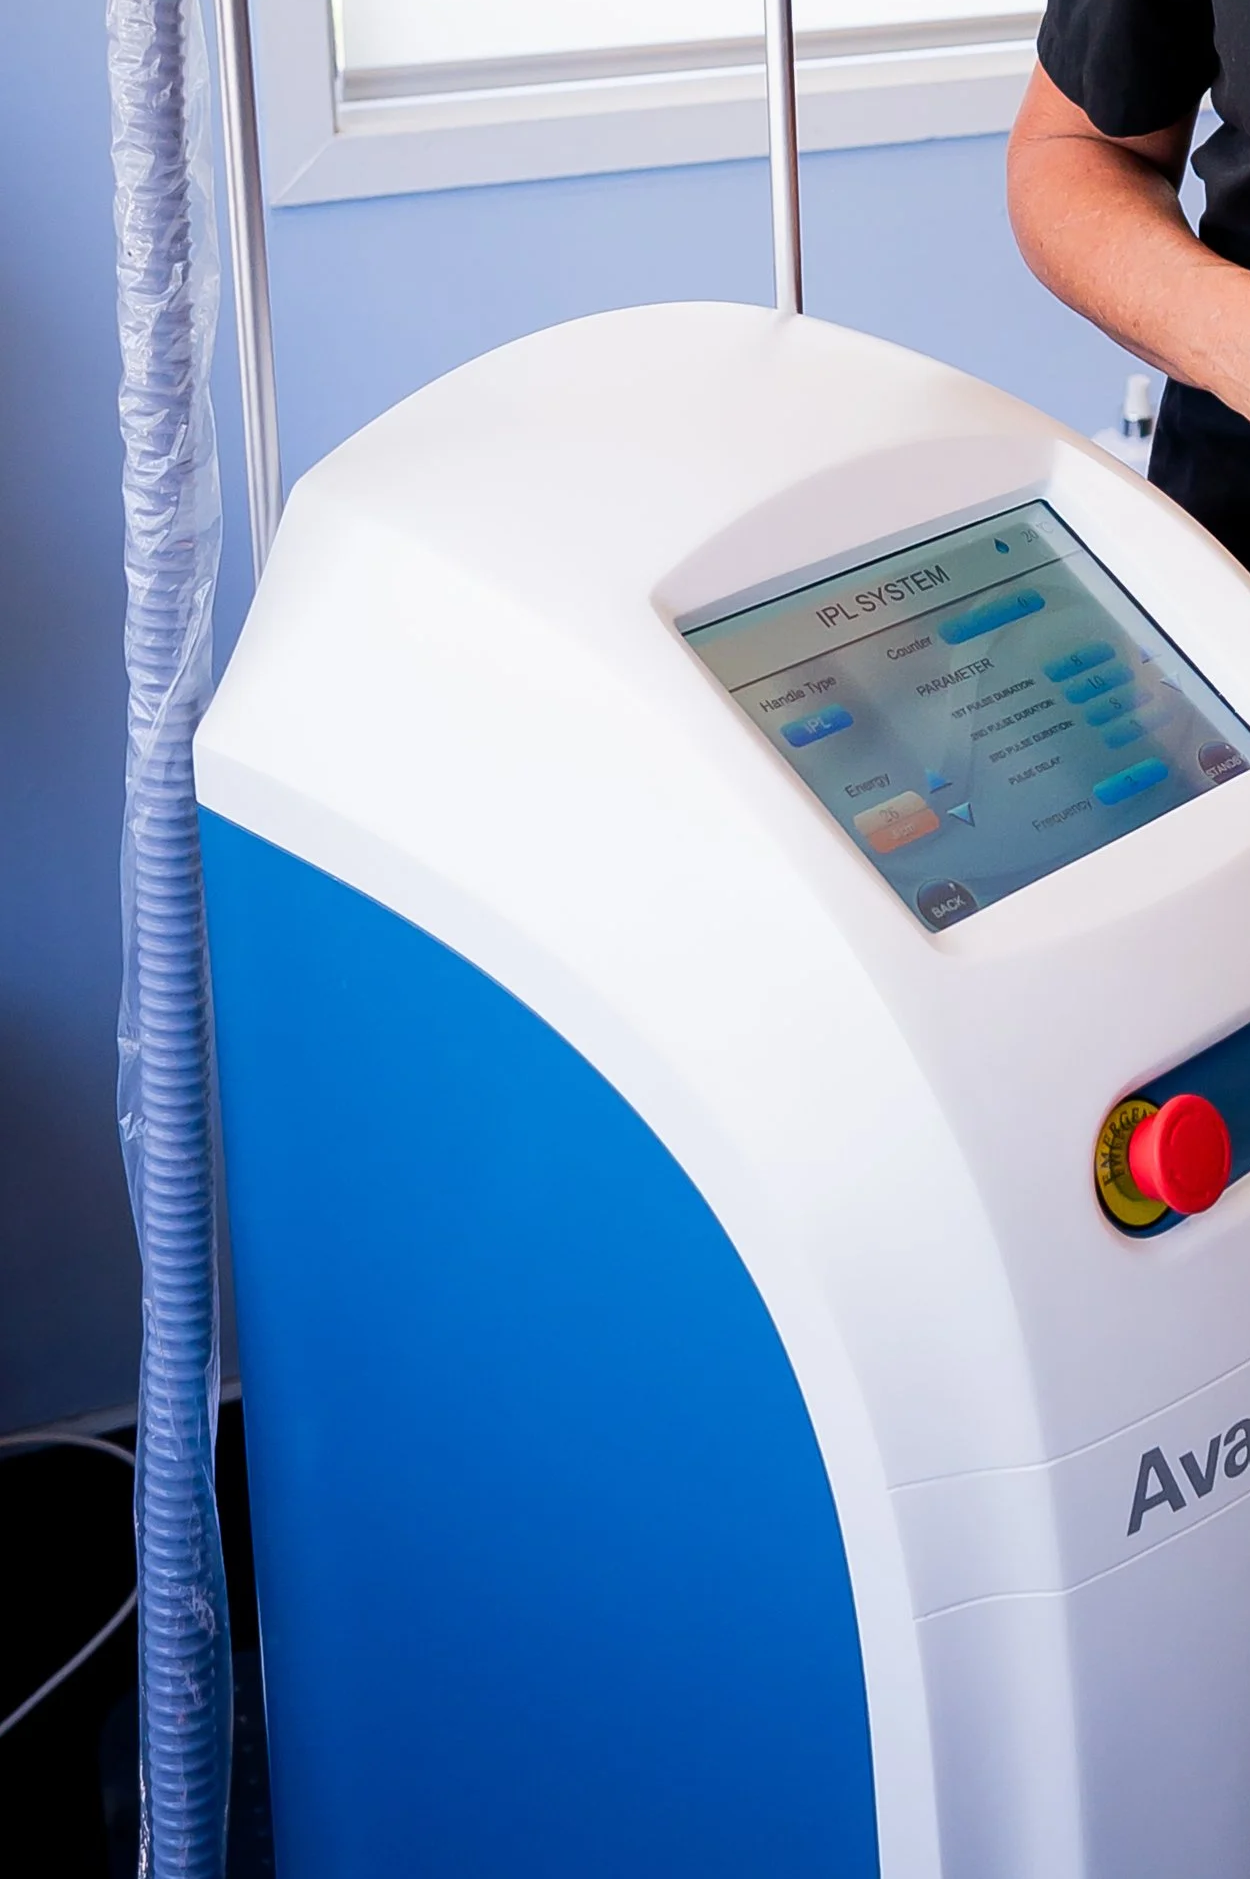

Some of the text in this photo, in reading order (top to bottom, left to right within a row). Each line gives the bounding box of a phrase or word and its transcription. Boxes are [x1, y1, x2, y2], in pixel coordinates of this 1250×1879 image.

[815, 564, 951, 628] IPL SYSTEM
[886, 635, 933, 661] Counter
[915, 657, 995, 698] PARAMETER
[759, 676, 837, 713] Handle Type
[804, 716, 833, 734] IPL
[844, 773, 890, 798] Energy
[1031, 798, 1093, 833] Frequency
[931, 894, 967, 919] BACK
